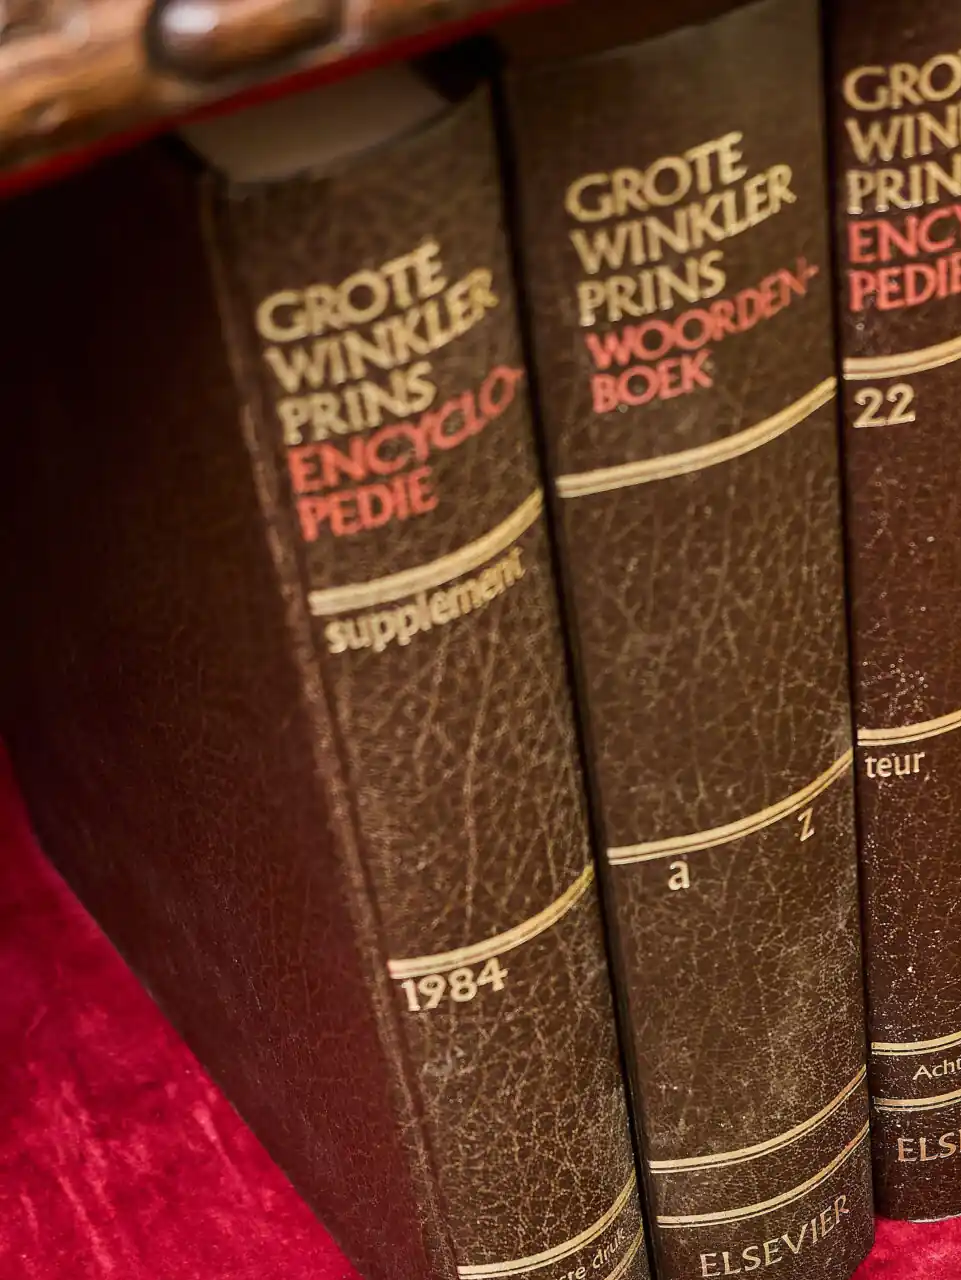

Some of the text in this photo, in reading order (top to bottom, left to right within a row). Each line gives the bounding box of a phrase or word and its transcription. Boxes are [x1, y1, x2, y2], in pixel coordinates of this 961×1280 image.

[565, 131, 748, 222] GROTE
[569, 164, 797, 274] WINKLER
[256, 239, 445, 343] GROTE
[577, 250, 726, 326] PRINS
[585, 257, 819, 369] WOORDEN-
[263, 267, 498, 392] WINKLER
[277, 361, 437, 445] PRINS
[590, 349, 713, 413] BOEK
[854, 383, 916, 428] 22
[297, 466, 438, 542] PEDIE
[325, 547, 525, 653] supplement
[865, 751, 925, 778] teur
[668, 808, 815, 890] a z
[401, 957, 508, 1011] 1984
[593, 1227, 626, 1269] druk
[700, 1195, 849, 1277] ELSEVIER
